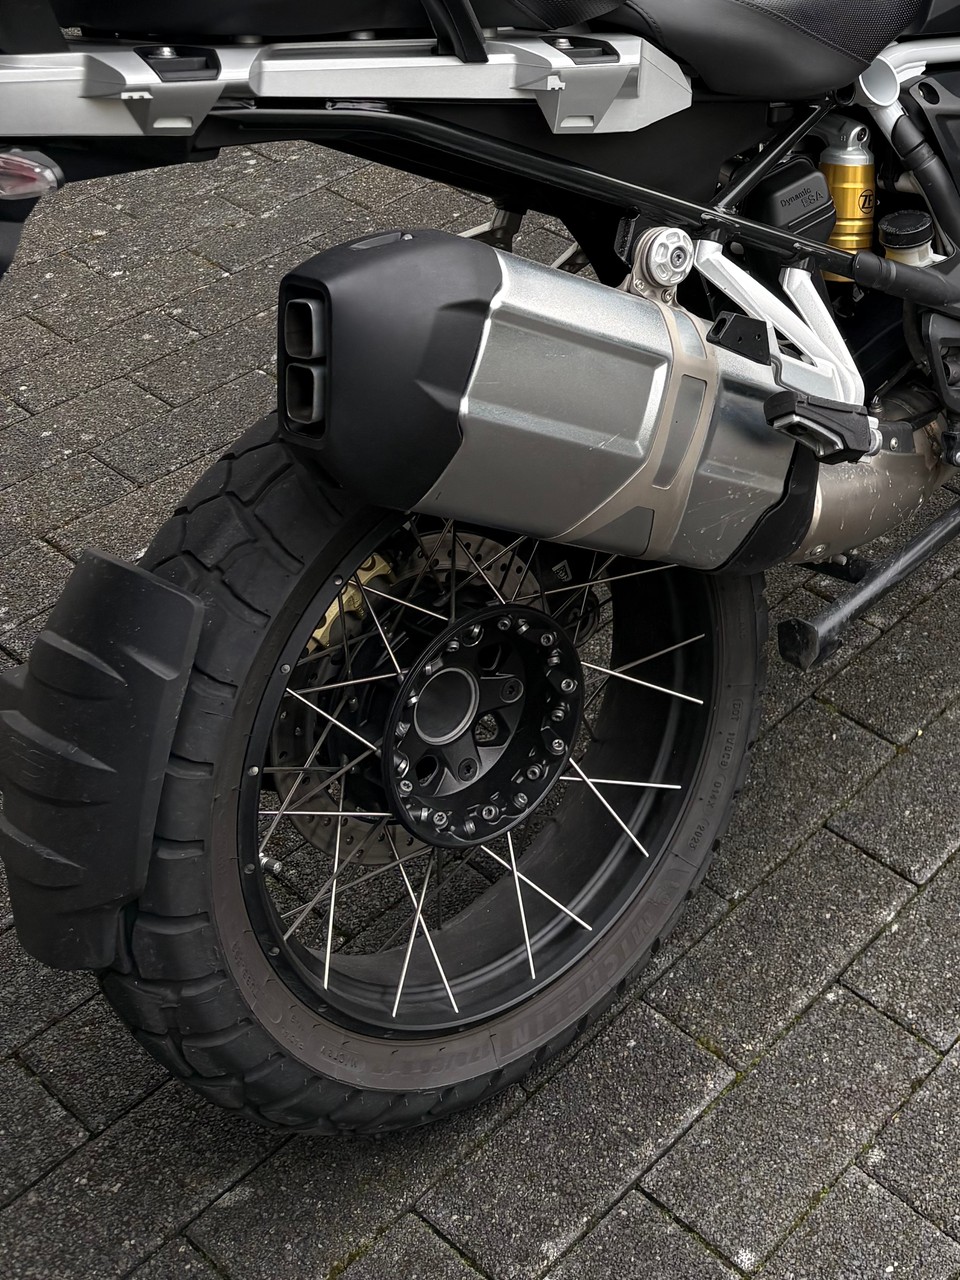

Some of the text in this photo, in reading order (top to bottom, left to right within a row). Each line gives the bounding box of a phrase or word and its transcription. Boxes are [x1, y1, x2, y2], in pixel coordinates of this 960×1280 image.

[780, 187, 812, 208] Dynamic
[801, 190, 825, 208] ESA
[511, 924, 653, 1052] MICHELIN
